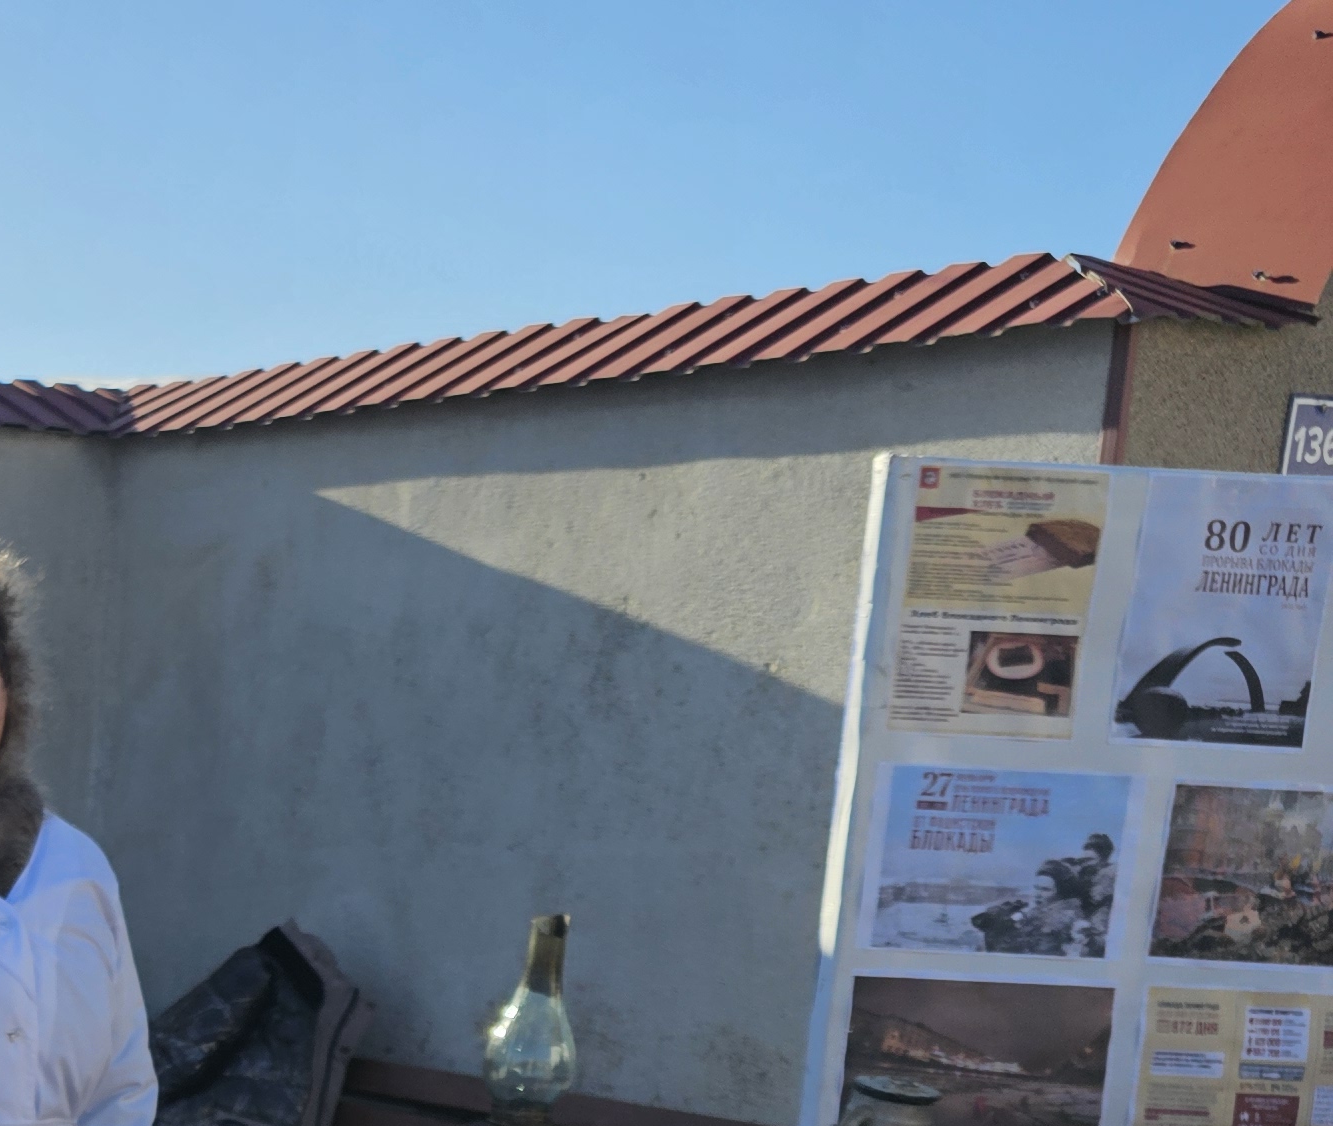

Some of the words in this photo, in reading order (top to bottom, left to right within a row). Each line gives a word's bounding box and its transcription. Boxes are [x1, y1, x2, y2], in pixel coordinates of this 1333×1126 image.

[1205, 519, 1251, 552] 80
[1262, 521, 1323, 544] ЛЕТ
[1195, 571, 1309, 601] ЛЕНИНГРАДА
